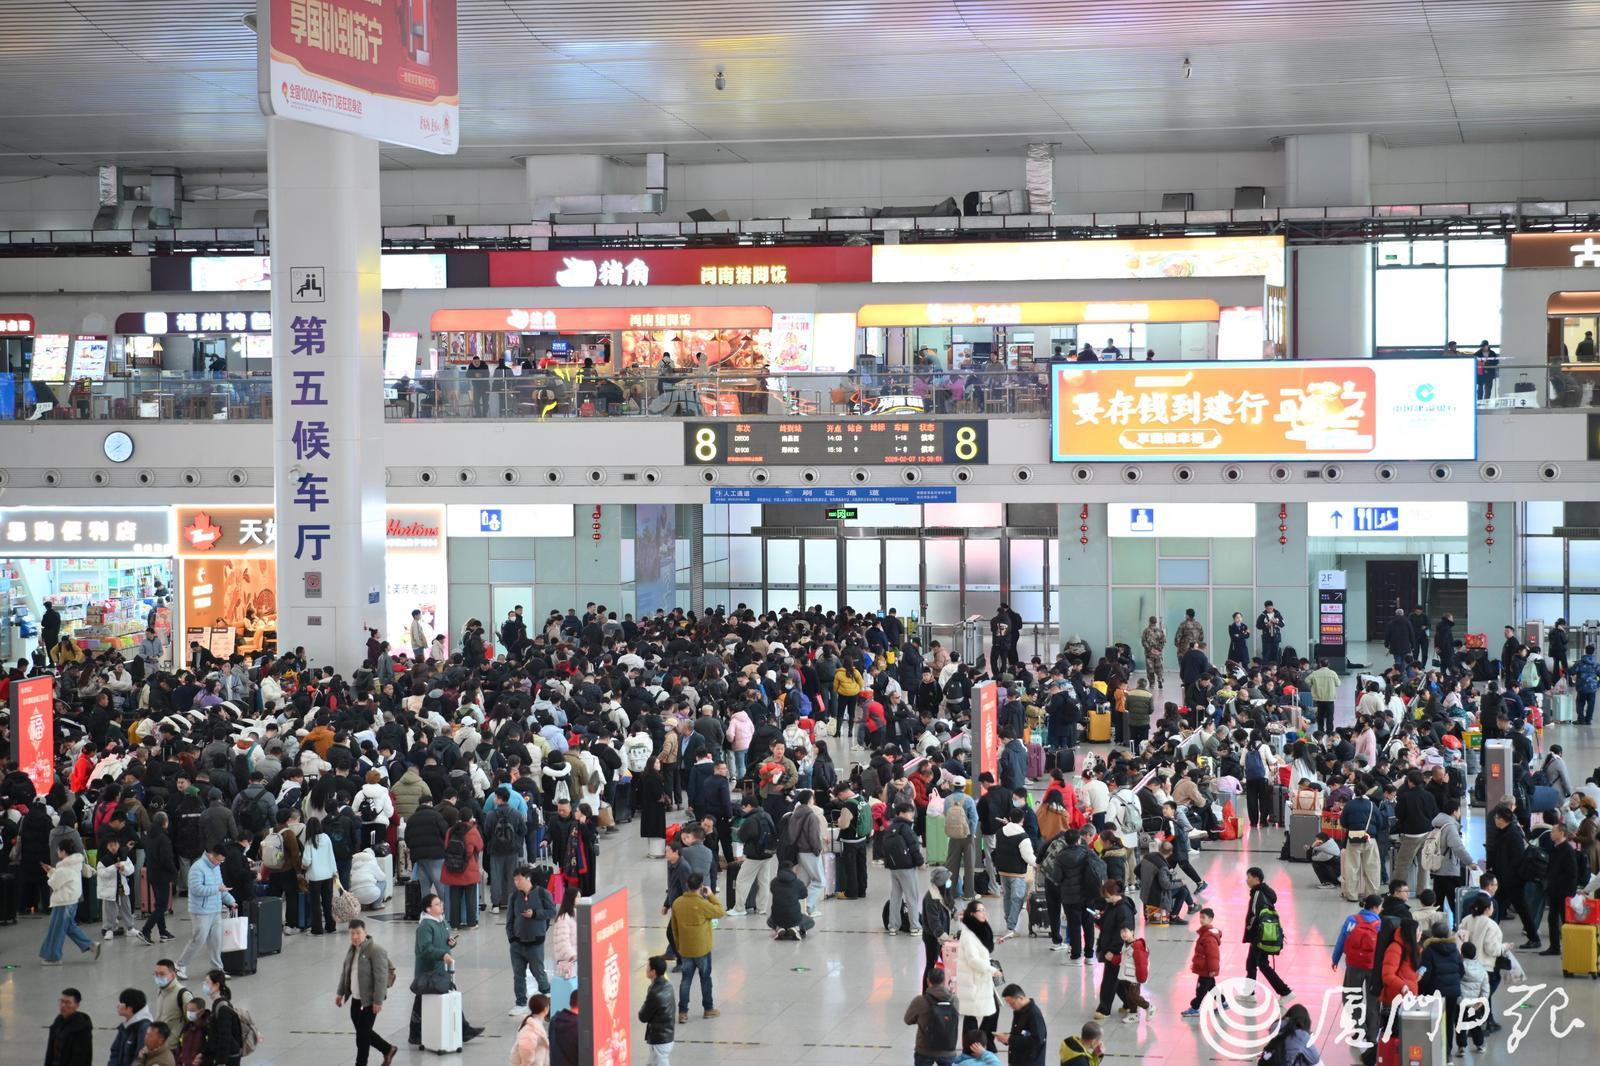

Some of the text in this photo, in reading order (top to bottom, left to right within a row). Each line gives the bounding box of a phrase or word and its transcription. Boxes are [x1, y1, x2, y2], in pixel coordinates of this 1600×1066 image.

[701, 266, 788, 285] 闽南猪脚饭
[1071, 389, 1270, 426] 要存钱到建行
[290, 316, 331, 561] 第五候车厅
[694, 428, 717, 461] 8
[954, 426, 978, 460] 8
[386, 518, 439, 537] Hortons
[1321, 573, 1333, 582] 2F
